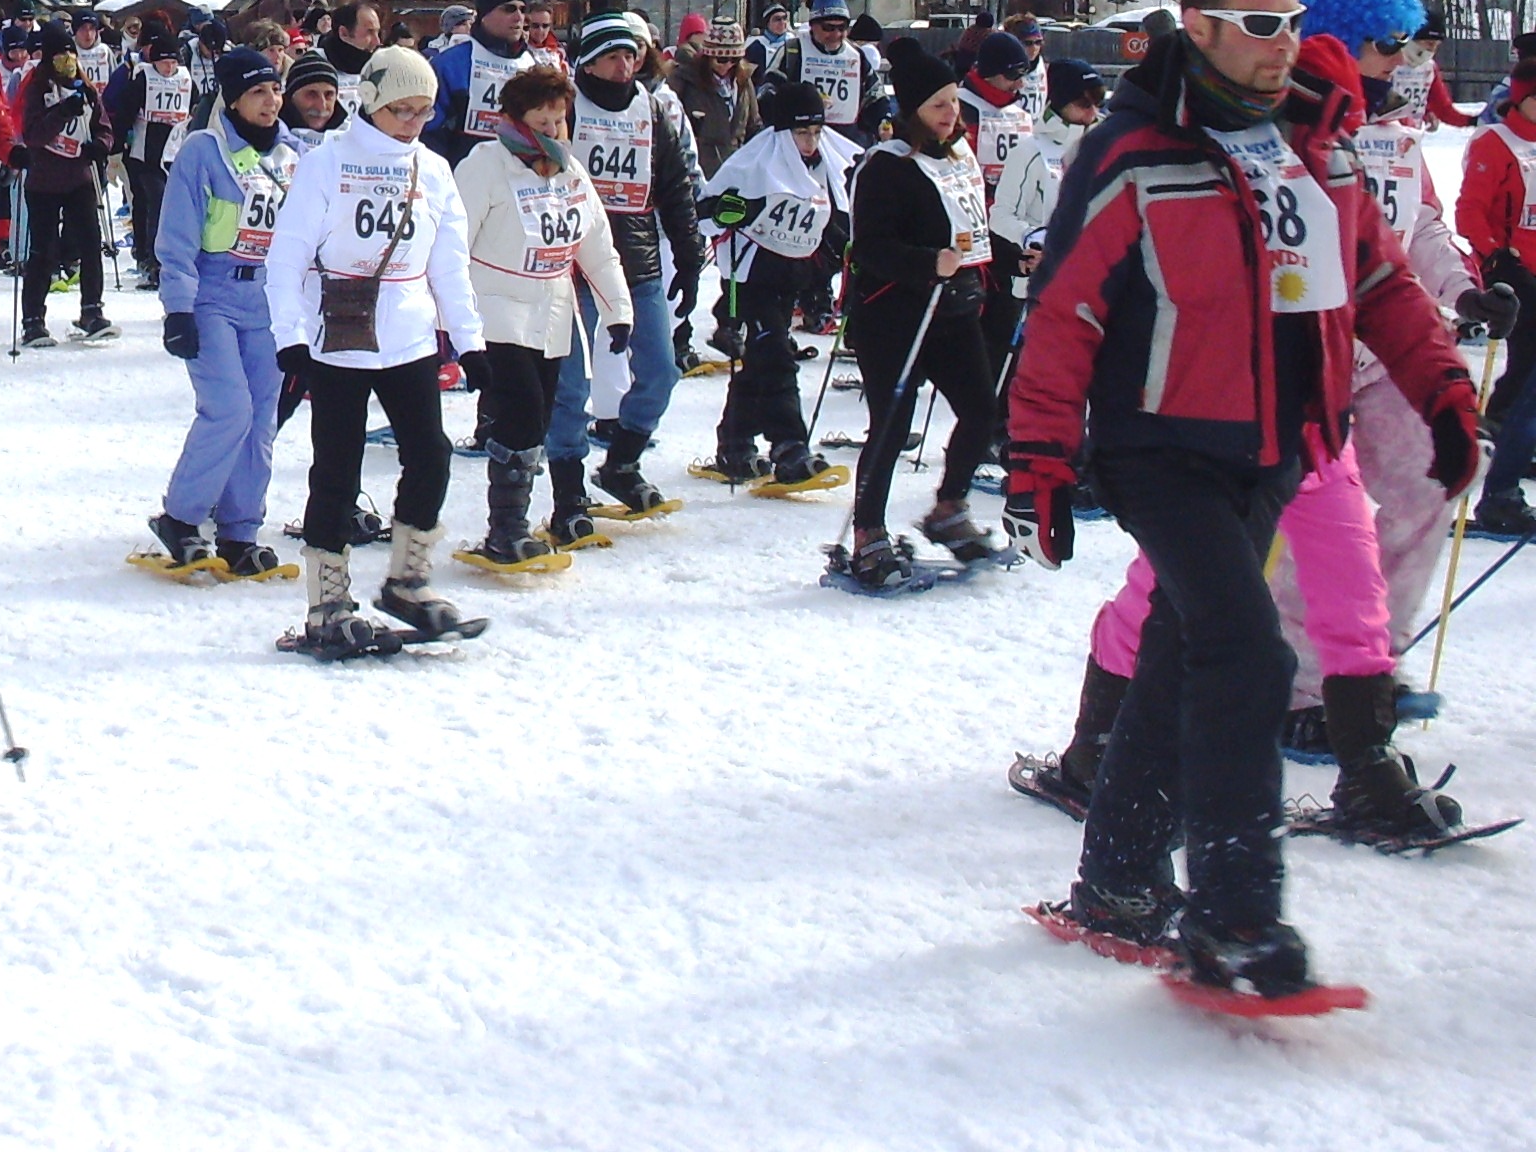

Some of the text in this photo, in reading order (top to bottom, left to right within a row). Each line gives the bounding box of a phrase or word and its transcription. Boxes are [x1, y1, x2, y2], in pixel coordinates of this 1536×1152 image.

[155, 92, 182, 110] 170
[814, 77, 848, 101] 576
[341, 163, 363, 175] FESTA
[365, 166, 390, 175] SULLA
[589, 145, 637, 180] 644
[540, 207, 582, 246] 642
[769, 199, 816, 234] 414
